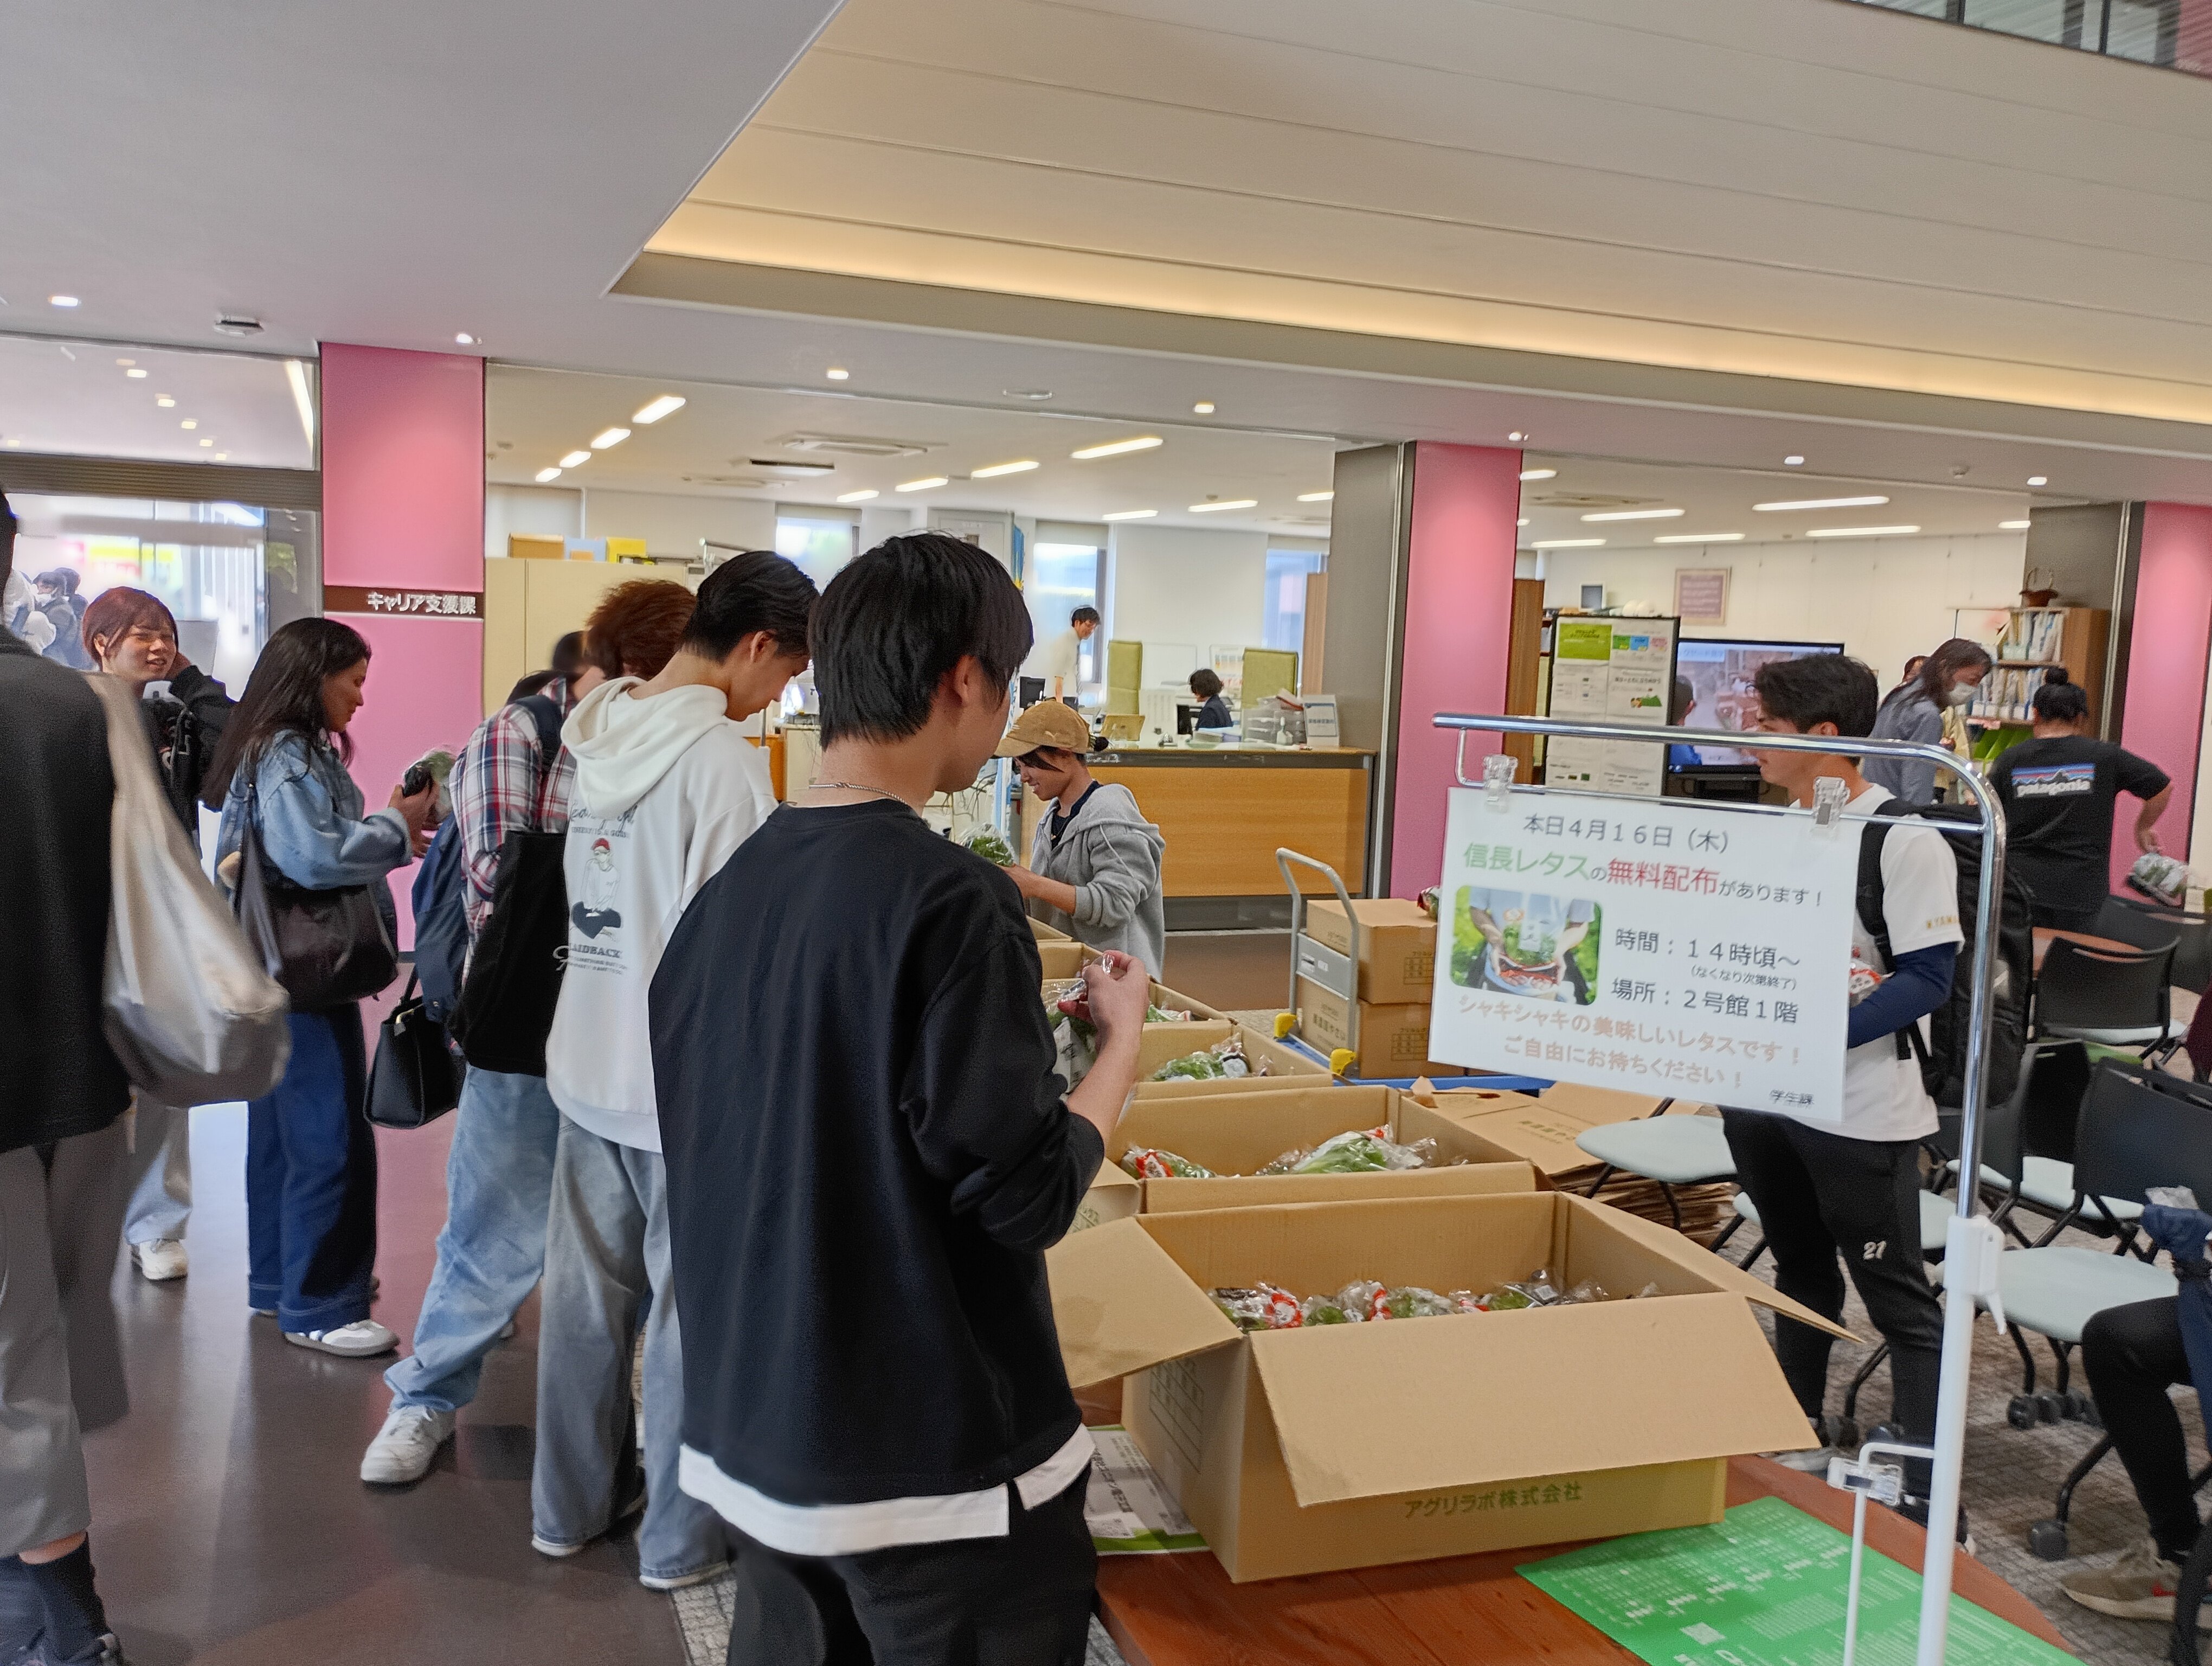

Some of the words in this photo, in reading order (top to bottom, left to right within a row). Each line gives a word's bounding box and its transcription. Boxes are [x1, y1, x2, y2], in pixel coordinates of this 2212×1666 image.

[368, 592, 476, 614] キャリア支援課
[1523, 812, 1728, 854] 本日4月16日（木）
[1464, 842, 1822, 907] 信長レタスの無料配布があります！
[1690, 964, 1798, 991] （なくなり次第終了）
[1611, 977, 1799, 1024] 場所：2号館1階
[1459, 994, 1799, 1065] シャキシャキの美味しいレタスです！
[1504, 1034, 1742, 1088] ご自由にお持ちください！
[1769, 1088, 1815, 1108] 学生課
[1863, 1240, 1887, 1260] 21
[1404, 1482, 1583, 1519] アグリラボ株式会社
